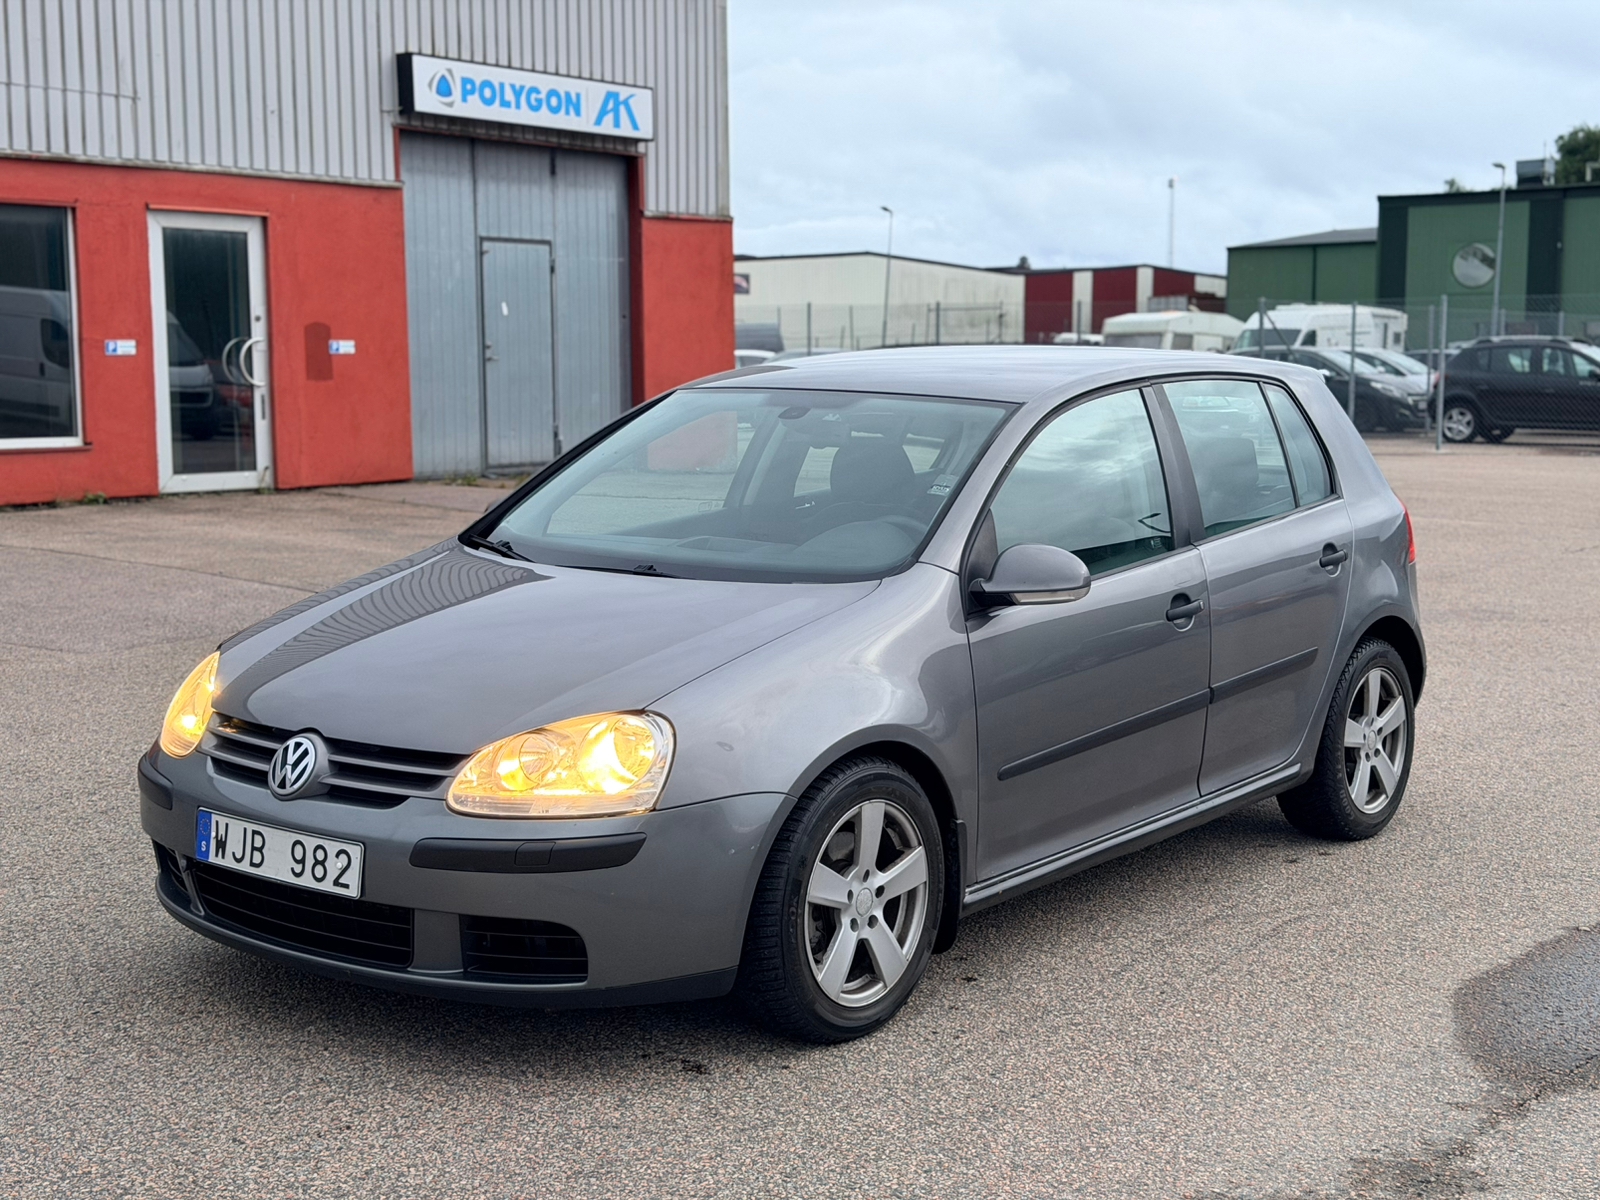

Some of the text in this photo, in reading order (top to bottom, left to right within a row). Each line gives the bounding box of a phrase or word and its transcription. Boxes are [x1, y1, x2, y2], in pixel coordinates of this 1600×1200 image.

[460, 76, 582, 118] POLYGON
[593, 90, 641, 131] AK
[201, 840, 207, 852] S
[214, 819, 353, 890] WJB 982
